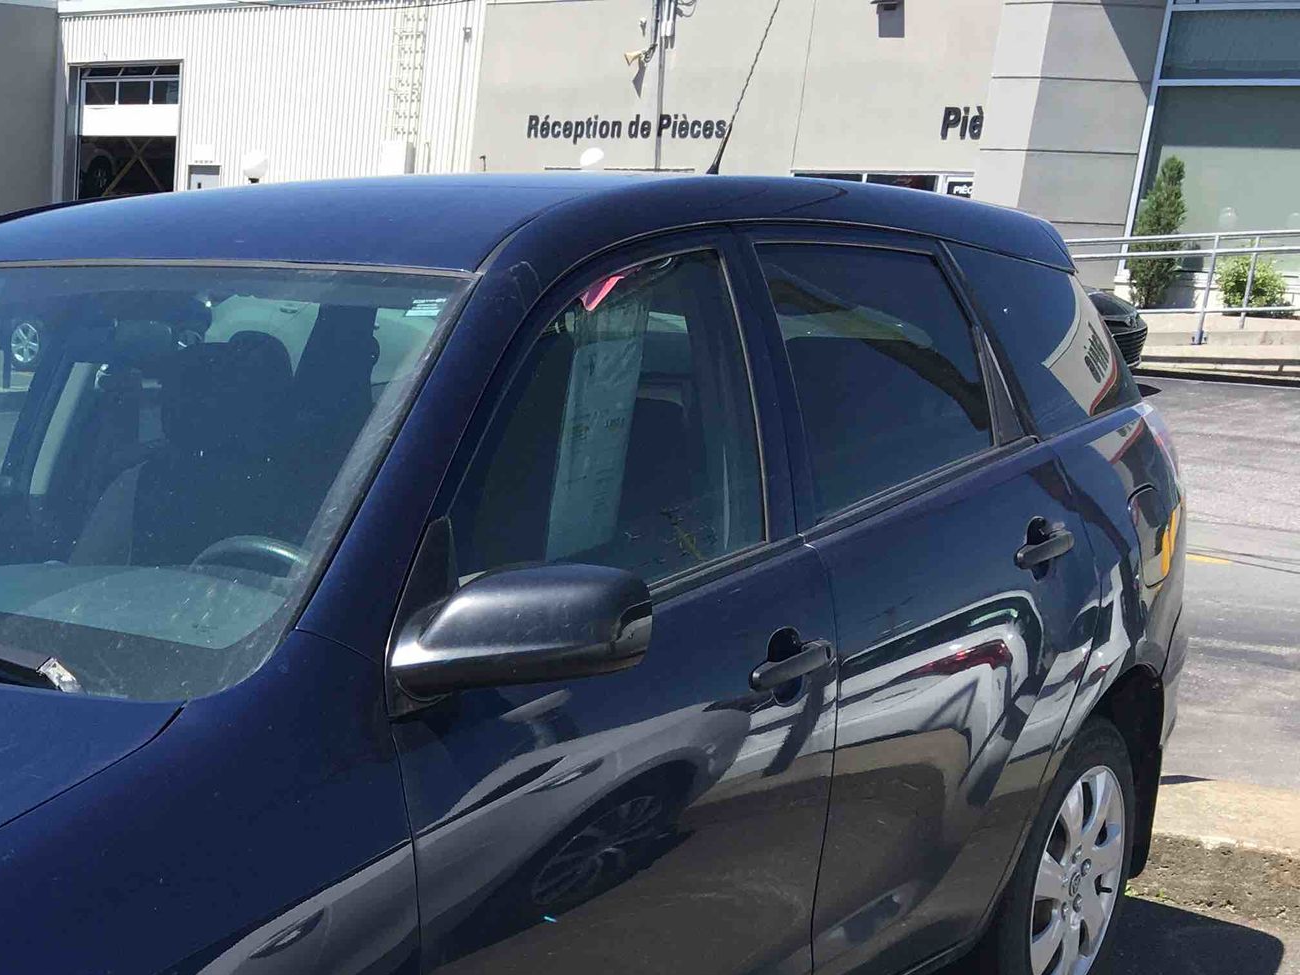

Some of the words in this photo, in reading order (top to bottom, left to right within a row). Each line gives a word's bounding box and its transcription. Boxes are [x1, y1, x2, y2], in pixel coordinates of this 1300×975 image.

[527, 114, 622, 145] Réception
[628, 114, 651, 139] de
[657, 113, 727, 139] Pièces
